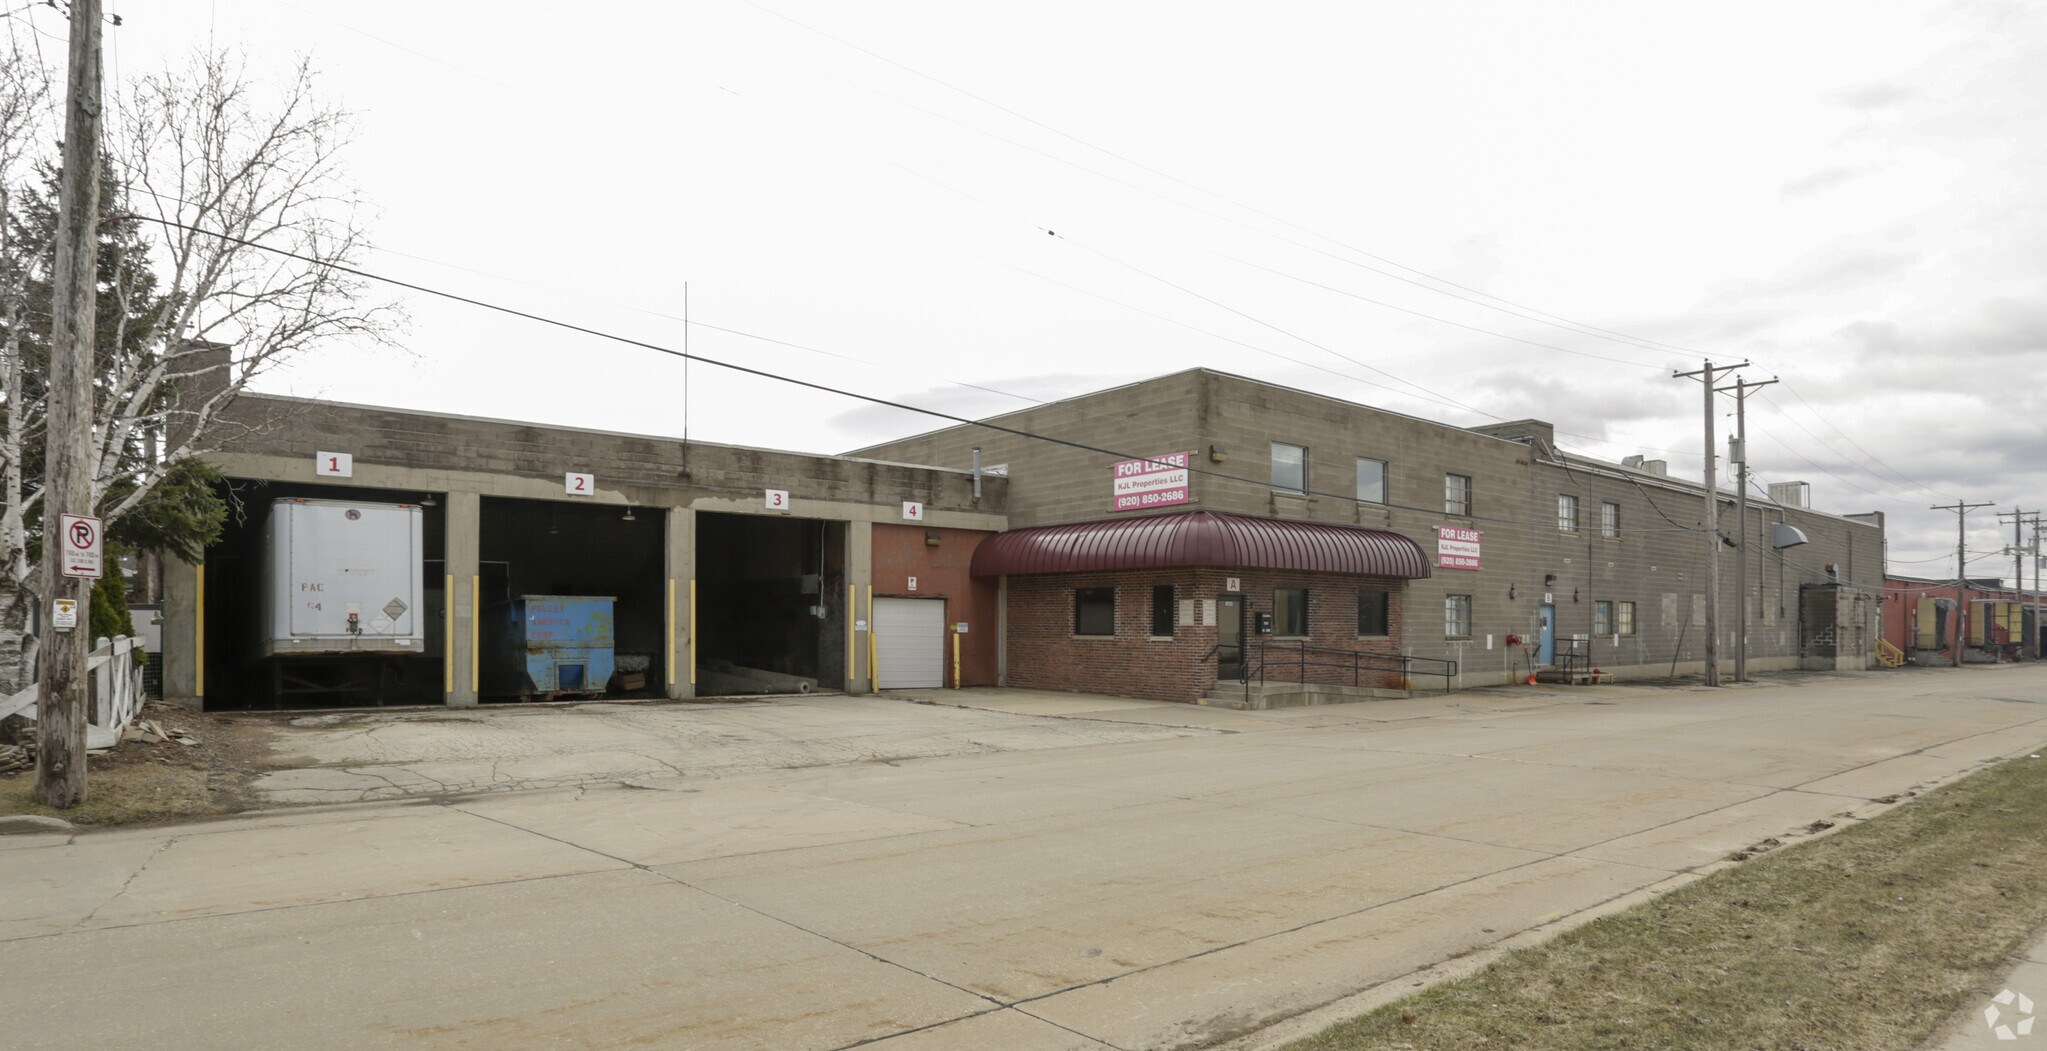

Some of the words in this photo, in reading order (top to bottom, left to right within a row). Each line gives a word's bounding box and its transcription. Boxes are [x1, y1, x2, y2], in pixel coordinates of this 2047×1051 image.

[329, 457, 340, 472] 1
[1118, 462, 1142, 476] FOR
[1145, 455, 1184, 472] LEASE
[575, 477, 585, 491] 2
[1132, 478, 1168, 488] Properties
[1170, 474, 1184, 483] LLC
[773, 493, 782, 506] 3
[1118, 496, 1140, 509] (920)
[1142, 490, 1184, 504] 850-2686
[909, 505, 917, 517] 4
[1441, 528, 1456, 539] FOR
[1457, 530, 1478, 542] LEASE
[1230, 580, 1236, 590] A
